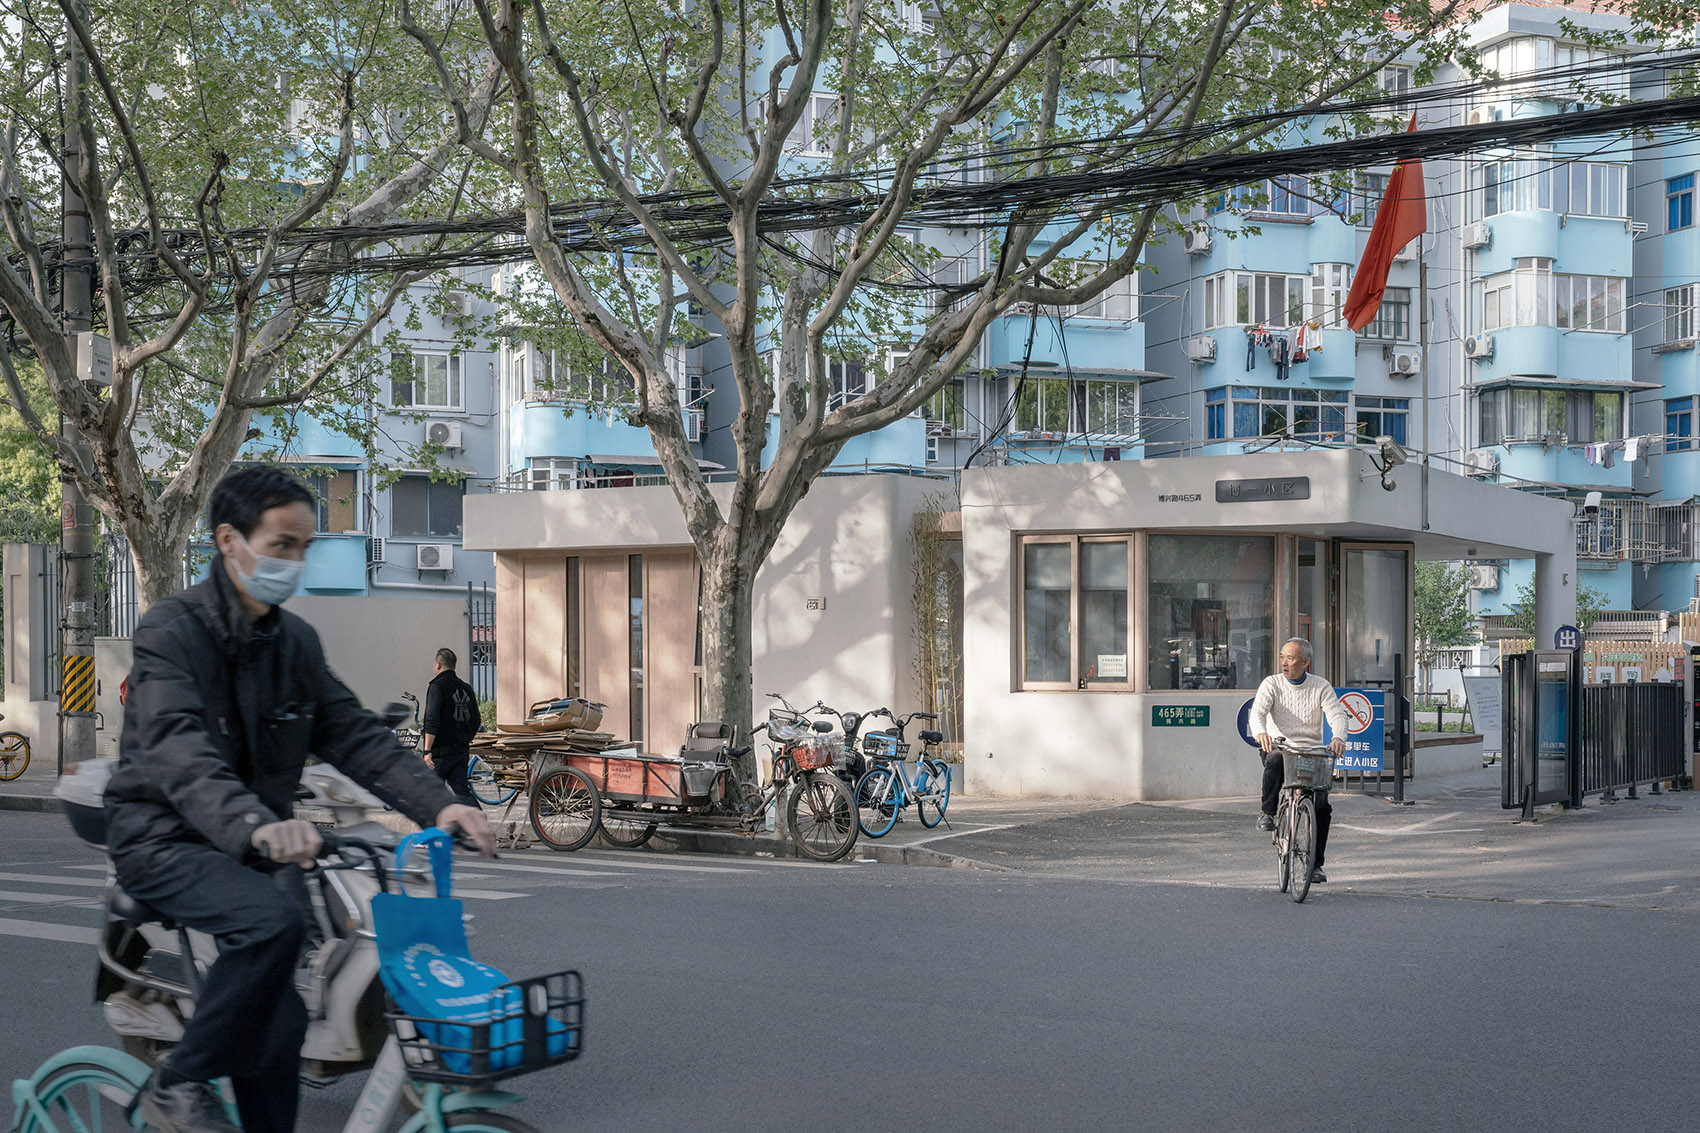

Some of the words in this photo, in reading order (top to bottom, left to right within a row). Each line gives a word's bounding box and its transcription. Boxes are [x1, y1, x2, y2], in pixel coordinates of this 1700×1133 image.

[1559, 629, 1576, 649] 出
[1345, 741, 1370, 751] 享单车
[1328, 756, 1379, 768] 止进入小区
